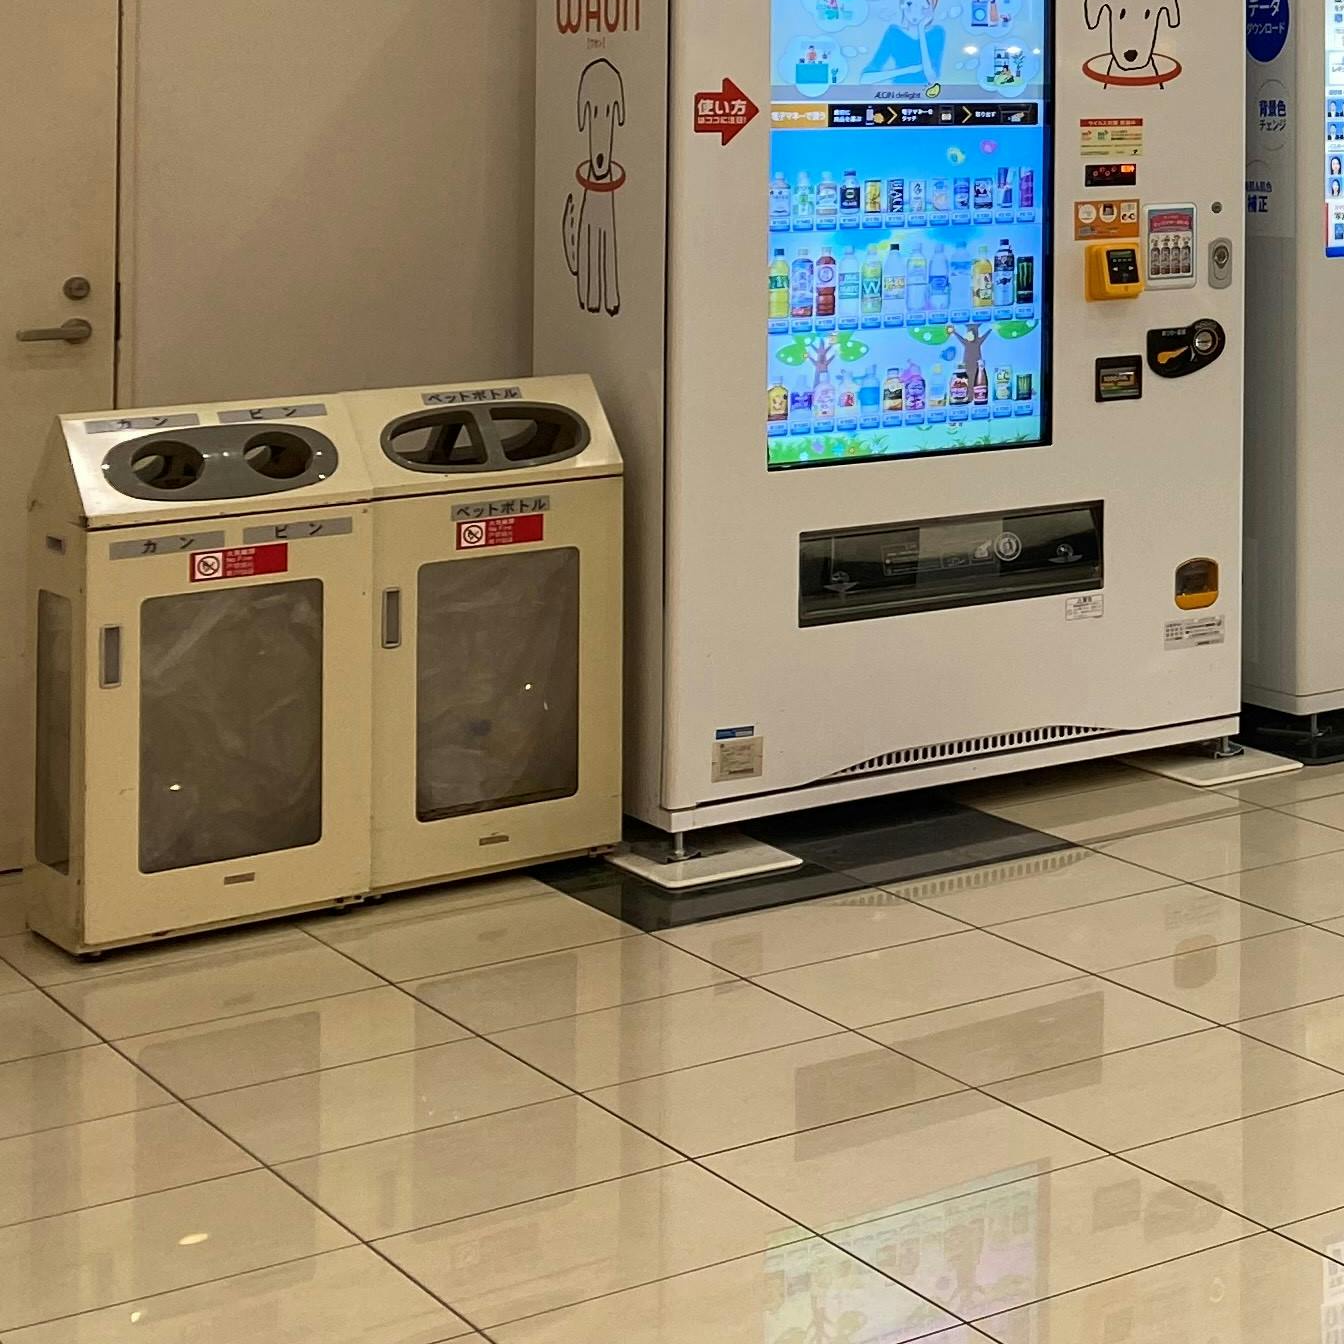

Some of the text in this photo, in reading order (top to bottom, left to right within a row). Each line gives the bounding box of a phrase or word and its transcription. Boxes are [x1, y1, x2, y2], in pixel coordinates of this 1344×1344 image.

[697, 98, 748, 116] 使い方
[1258, 99, 1287, 117] 背景色
[1258, 119, 1287, 132] チェンジ
[427, 388, 517, 404] ペットボトル
[116, 415, 168, 430] カン
[456, 498, 547, 518] ペットボトル
[274, 519, 325, 539] ビン
[141, 535, 196, 555] カン
